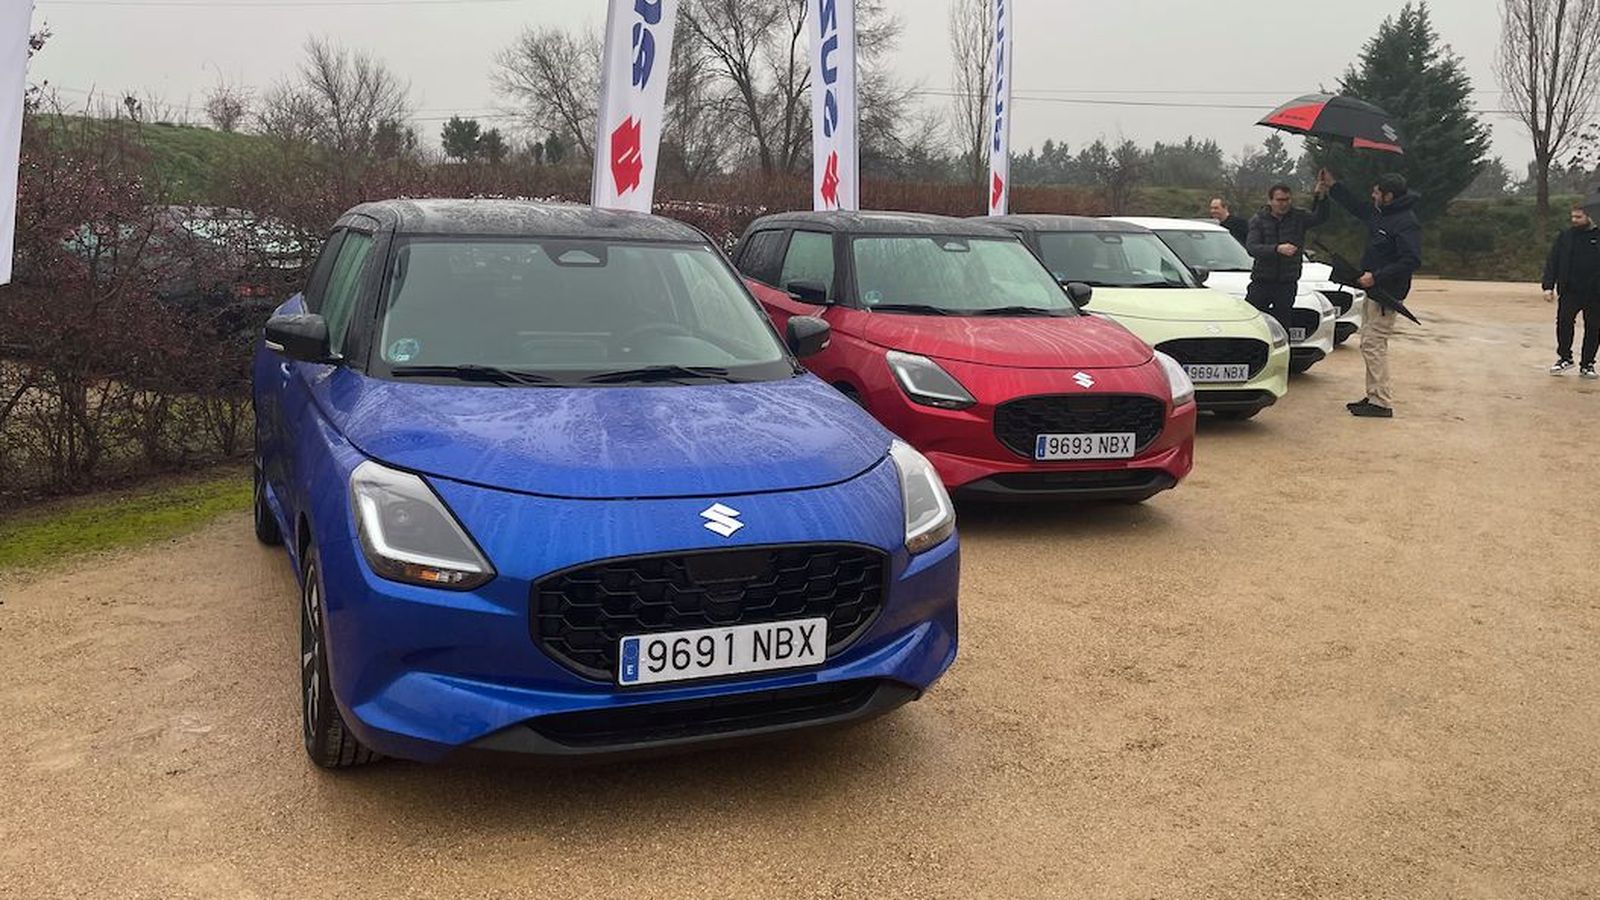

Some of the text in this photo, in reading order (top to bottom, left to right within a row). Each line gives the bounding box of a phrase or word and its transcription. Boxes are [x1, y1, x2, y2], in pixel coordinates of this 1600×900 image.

[1191, 366, 1246, 379] 9694 NBX
[1049, 436, 1093, 455] 9693
[1098, 436, 1131, 454] NBX
[647, 624, 816, 673] 9691 NBX
